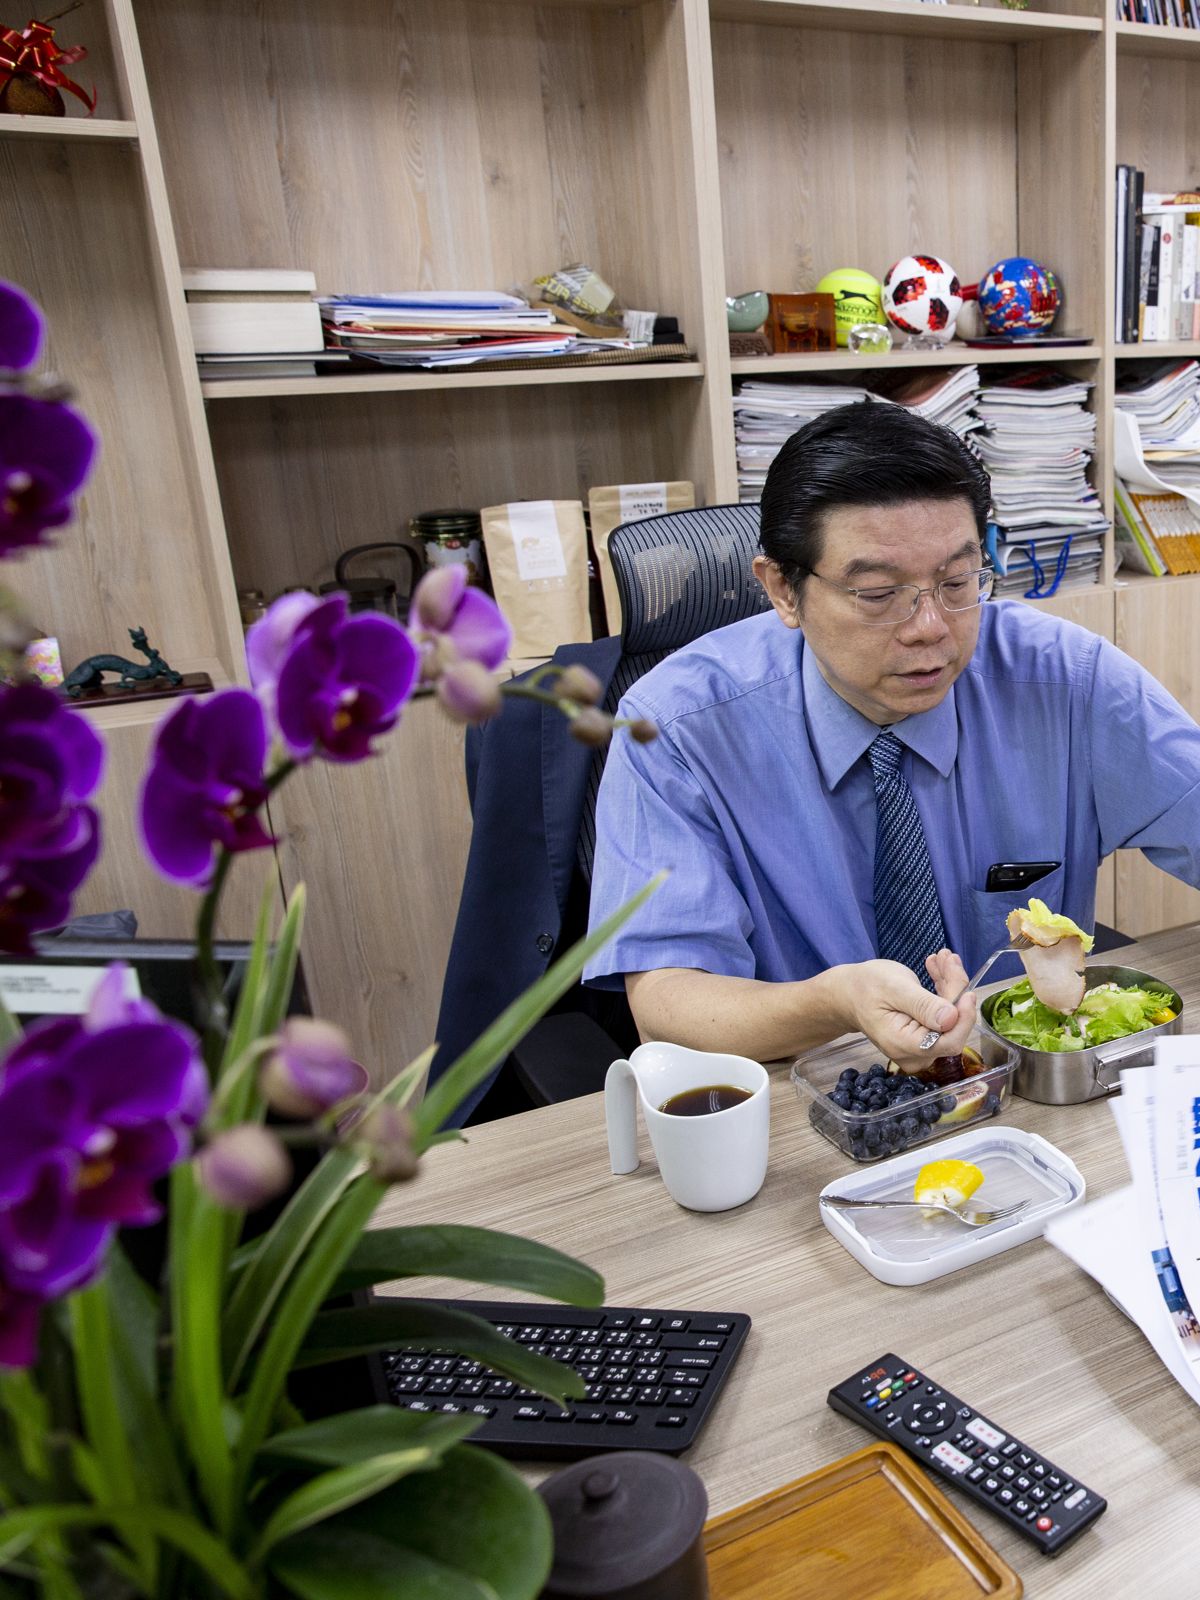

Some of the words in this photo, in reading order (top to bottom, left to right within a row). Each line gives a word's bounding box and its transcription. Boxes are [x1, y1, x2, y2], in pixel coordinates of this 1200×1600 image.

[988, 1457, 999, 1466] 0
[1022, 1454, 1032, 1464] 7
[1004, 1466, 1015, 1476] 8
[1033, 1465, 1044, 1475] 4
[986, 1479, 998, 1489] 9
[1018, 1478, 1029, 1487] 5
[1051, 1475, 1060, 1485] 1
[1002, 1490, 1013, 1500] 6
[1032, 1488, 1044, 1498] 2
[1017, 1501, 1028, 1510] 3
